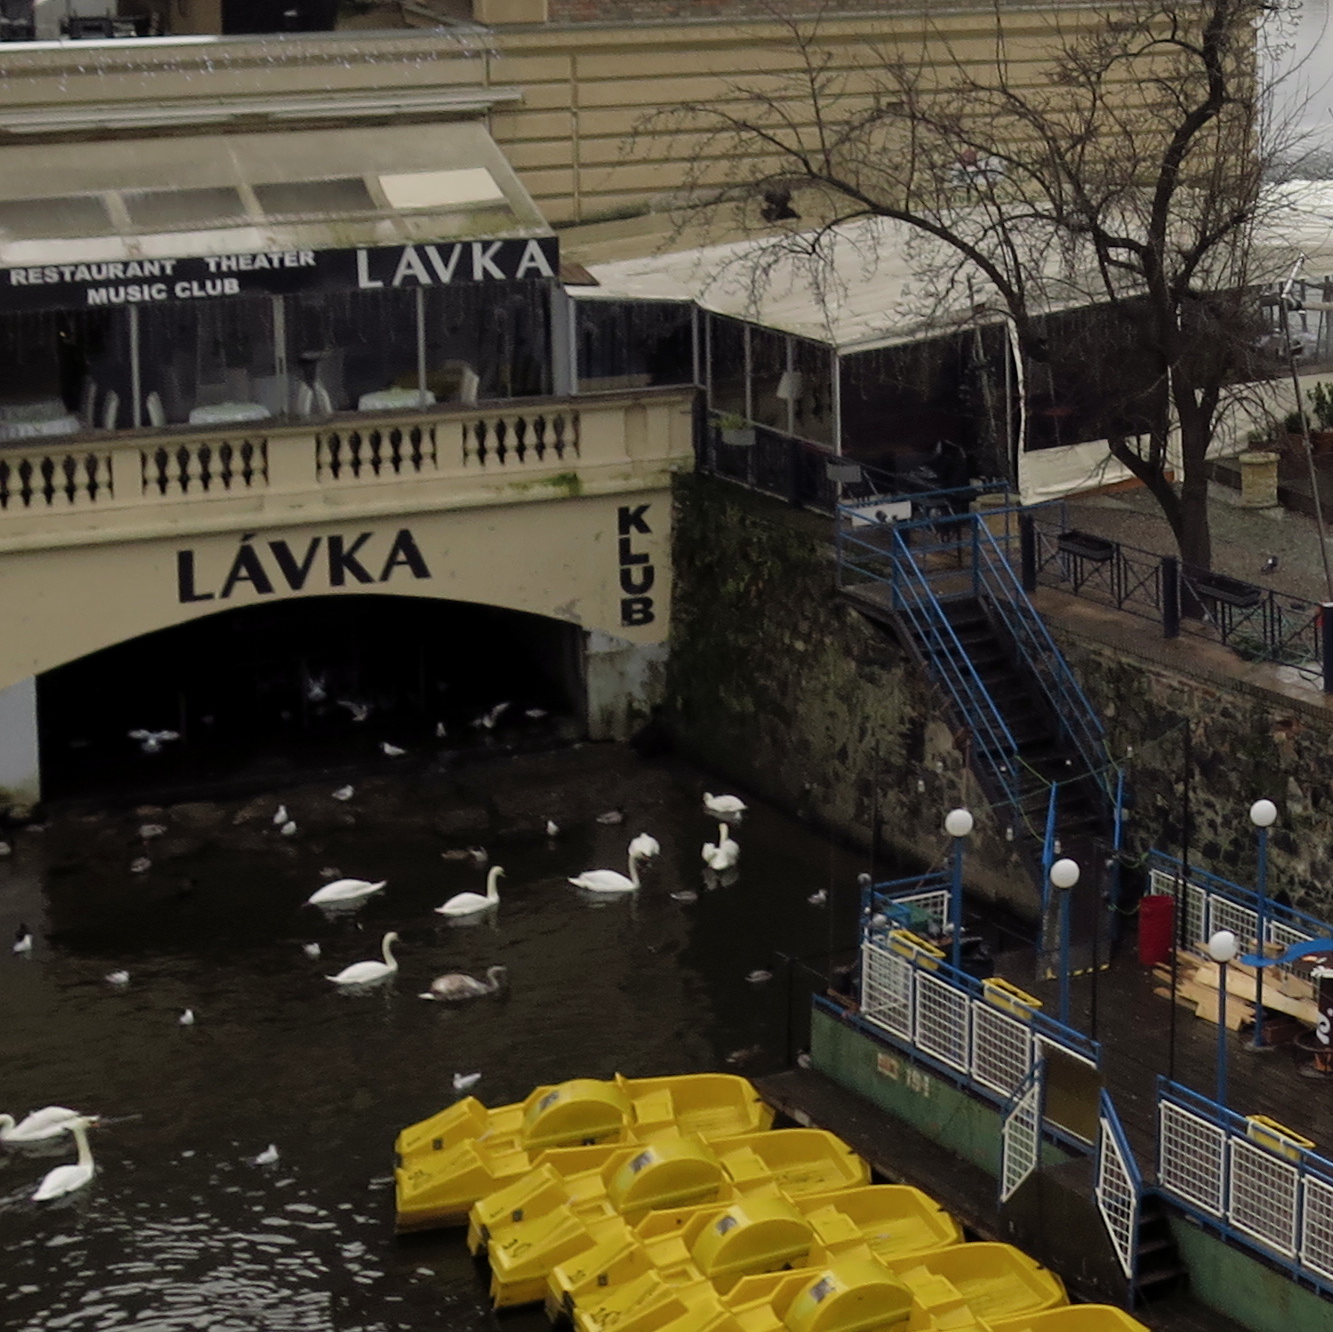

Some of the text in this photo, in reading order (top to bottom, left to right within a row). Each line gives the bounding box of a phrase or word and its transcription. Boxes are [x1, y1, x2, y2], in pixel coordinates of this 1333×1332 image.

[9, 249, 316, 286] RESTAURANT THEATER
[87, 277, 240, 305] MUSIC CLUB
[177, 528, 432, 604] LÁVKA
[618, 504, 655, 627] KLUB
